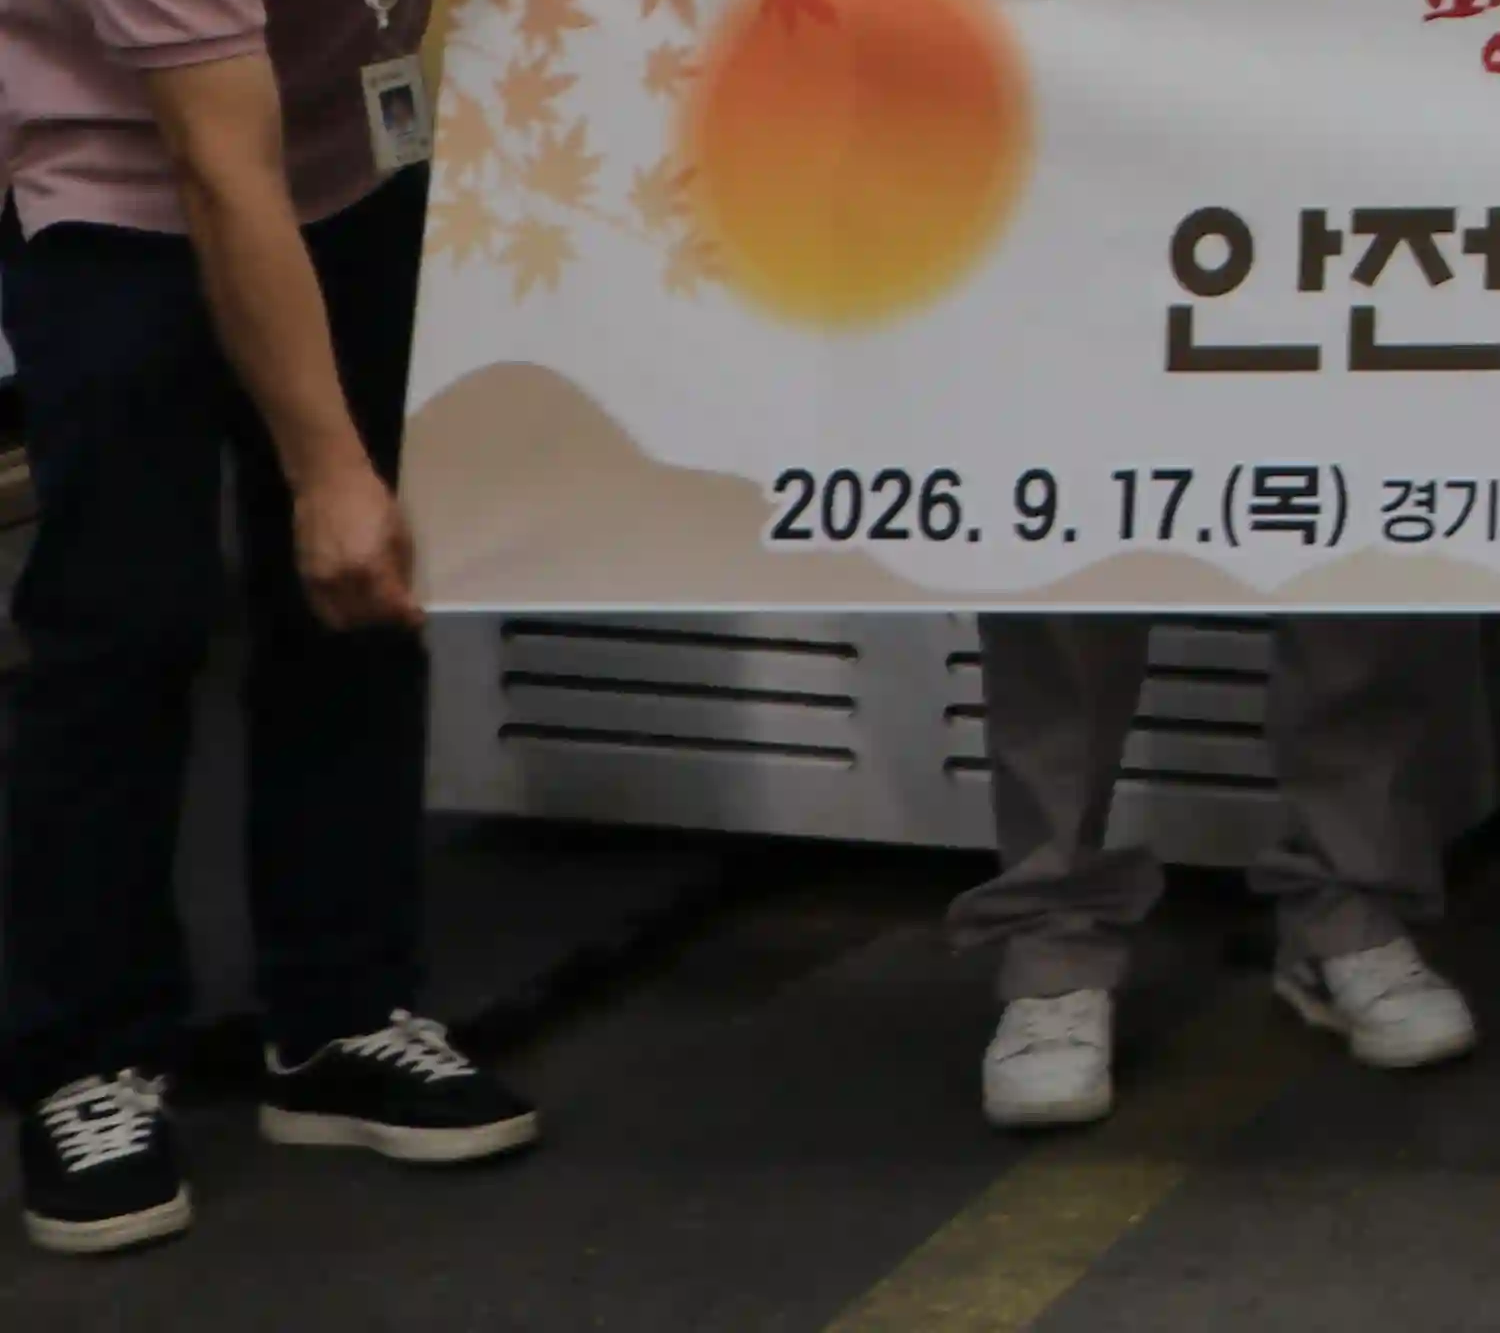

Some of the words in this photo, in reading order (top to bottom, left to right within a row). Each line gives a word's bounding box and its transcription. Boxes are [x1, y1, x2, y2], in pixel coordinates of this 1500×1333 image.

[770, 468, 984, 544] 2026.
[1013, 468, 1080, 544] 9.
[1111, 463, 1349, 547] 17.(목)
